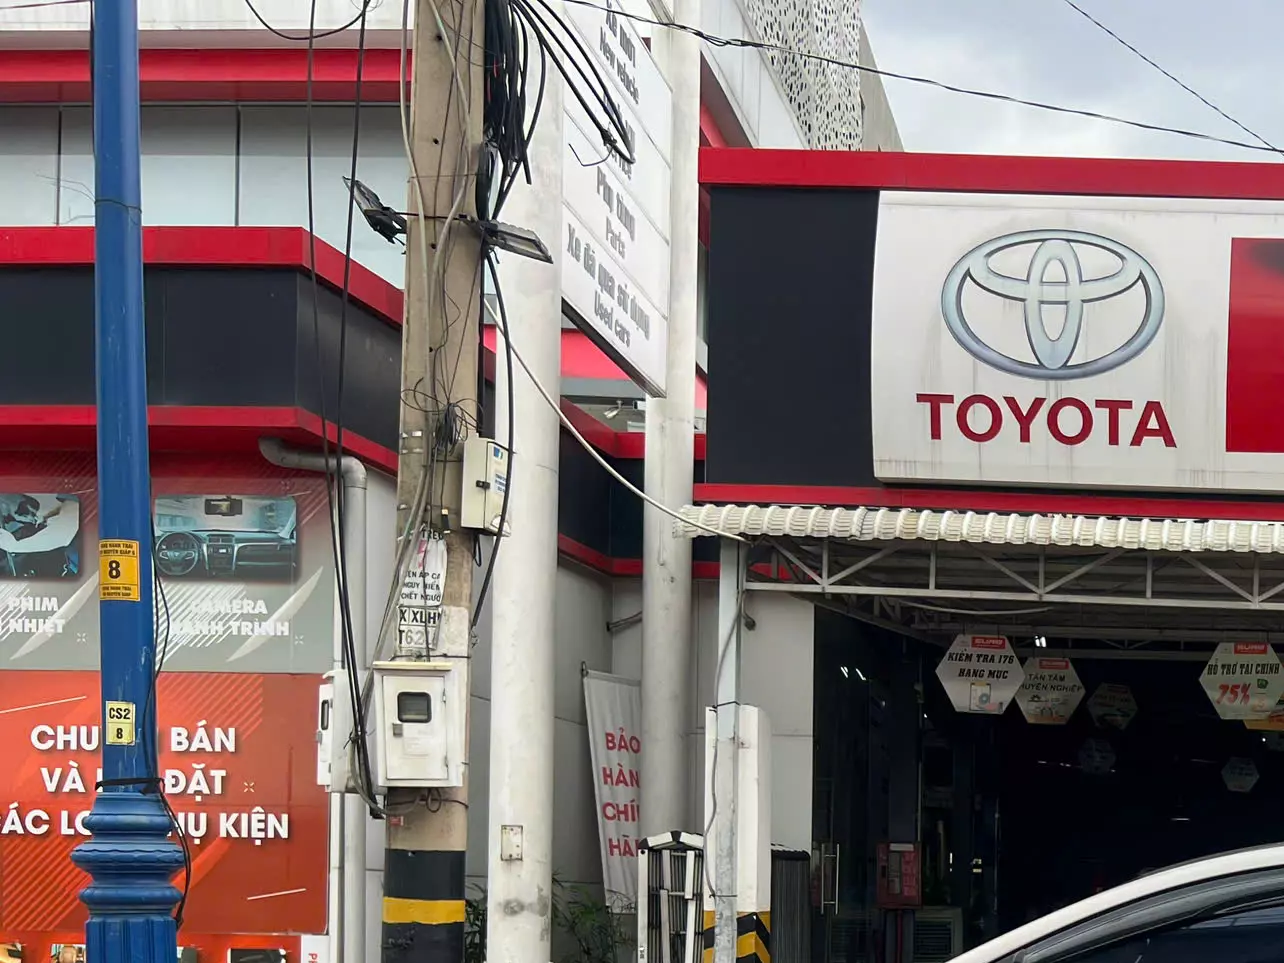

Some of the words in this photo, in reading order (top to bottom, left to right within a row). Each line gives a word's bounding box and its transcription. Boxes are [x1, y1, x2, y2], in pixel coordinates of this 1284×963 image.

[567, 222, 581, 263] Xe
[605, 216, 625, 259] Parts
[594, 290, 613, 332] Used
[614, 318, 631, 349] cars
[916, 392, 1177, 448] TOYOTA
[108, 560, 121, 579] 8
[8, 596, 58, 612] PHIM
[191, 599, 268, 614] CAMERA
[976, 654, 995, 664] TRA
[998, 655, 1015, 664] 176
[1216, 683, 1252, 705] 75%
[109, 707, 131, 720] CS2
[30, 725, 100, 750] CHU
[170, 720, 235, 752] BÁN
[116, 728, 123, 739] 8
[605, 727, 640, 754] BẢO
[40, 760, 86, 793] VÀ
[164, 763, 227, 801] ĐẶT
[602, 762, 640, 788] HÀN
[602, 798, 640, 822] CHÍ
[0, 802, 50, 835] ÁC
[219, 806, 289, 845] KIỆN
[608, 834, 639, 857] HÃ
